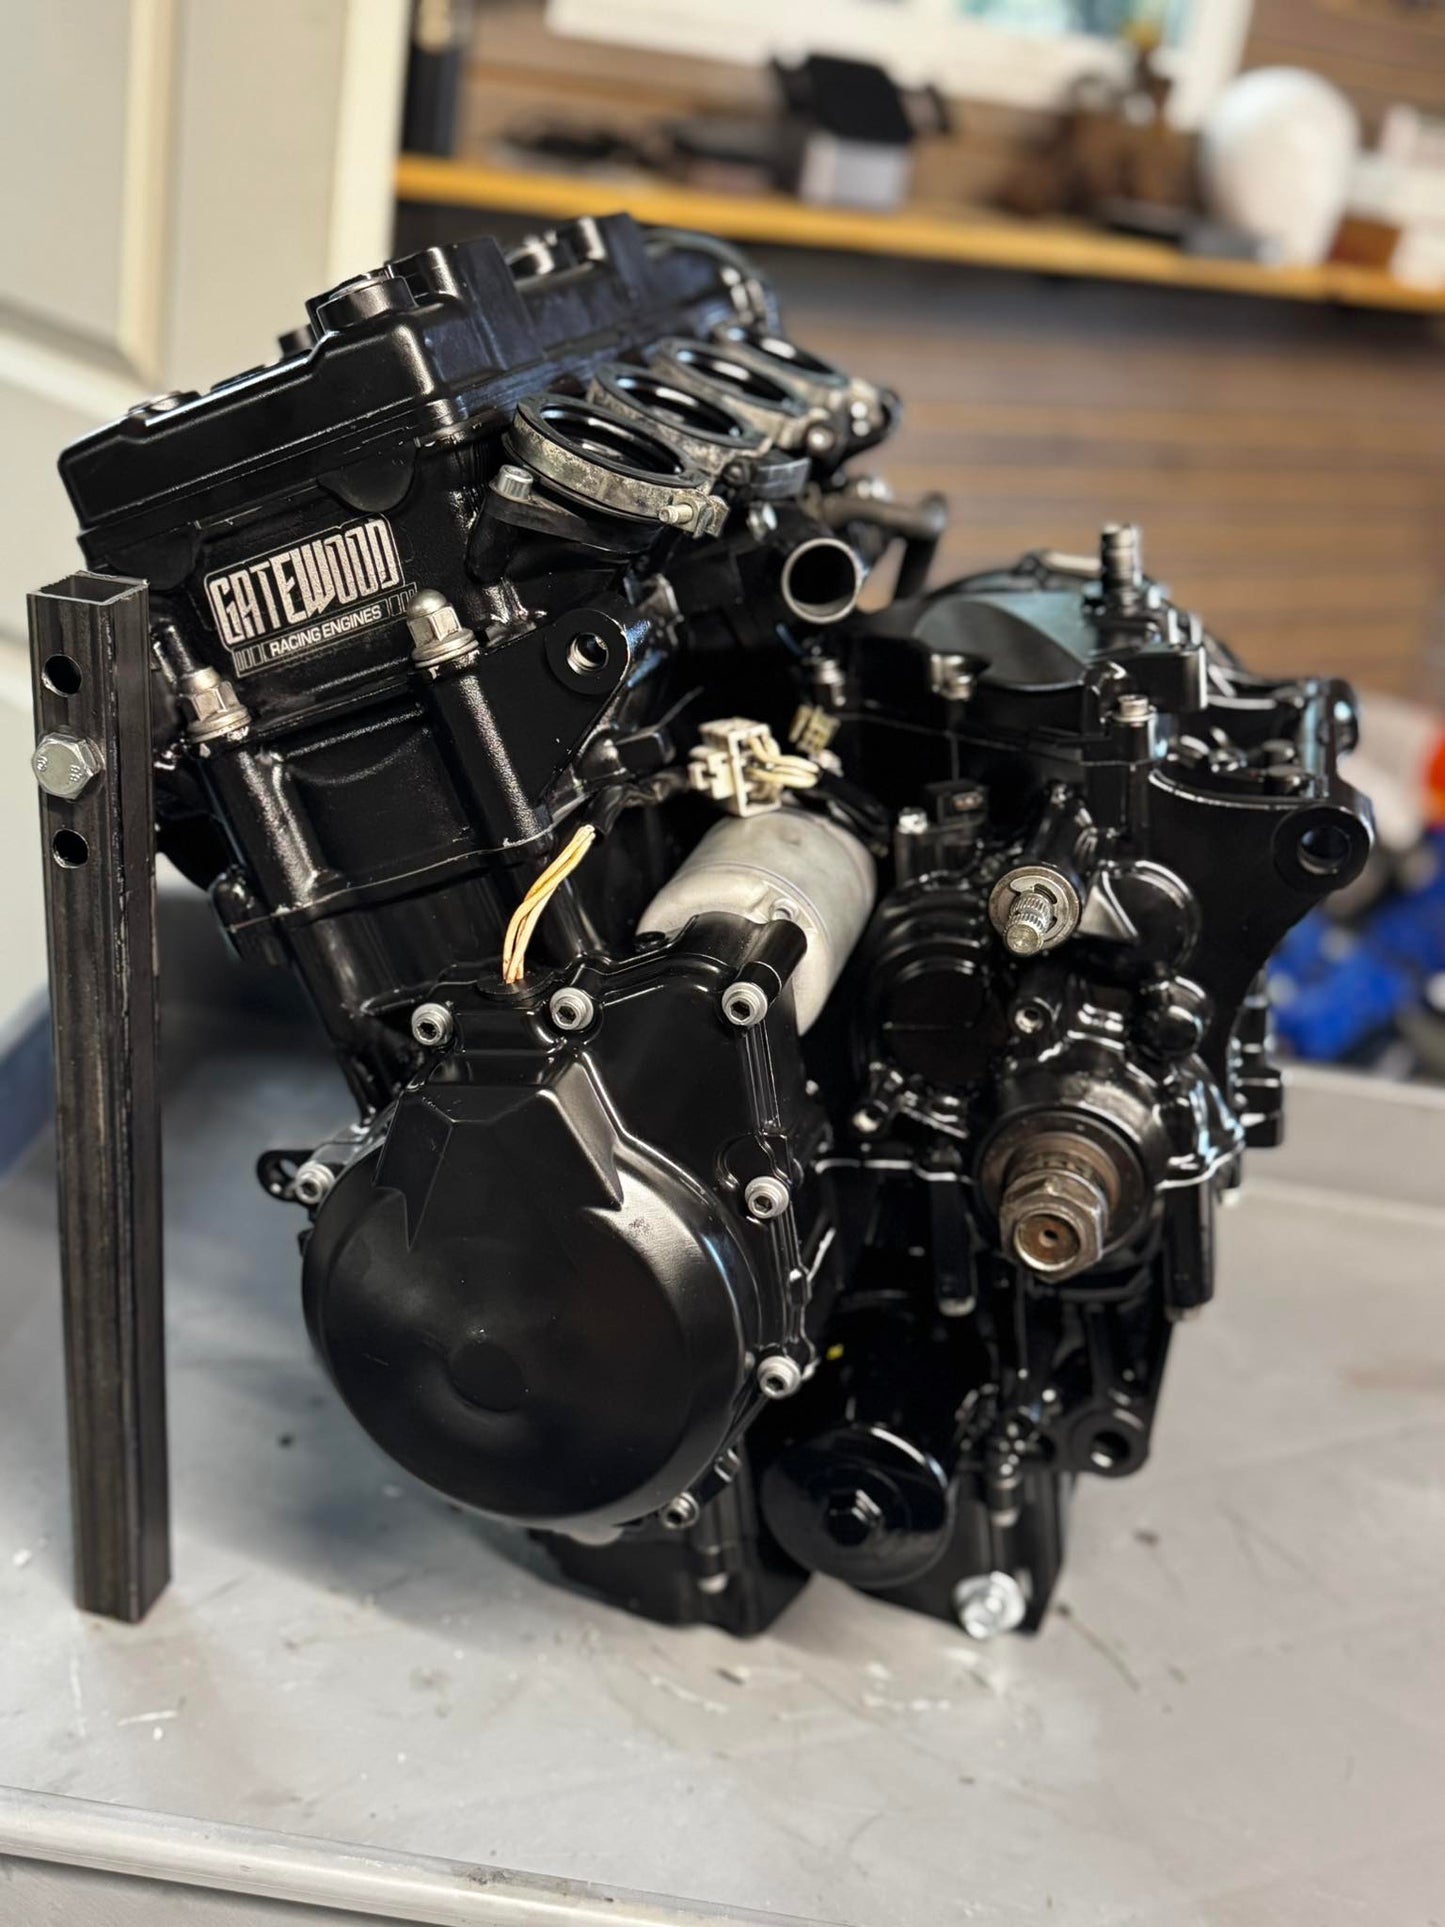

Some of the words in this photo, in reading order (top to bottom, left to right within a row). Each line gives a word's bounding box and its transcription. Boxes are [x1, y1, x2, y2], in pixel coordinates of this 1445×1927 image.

[209, 519, 400, 644] GATEWOOD
[269, 626, 321, 657] RACING
[322, 605, 382, 638] ENGINES
